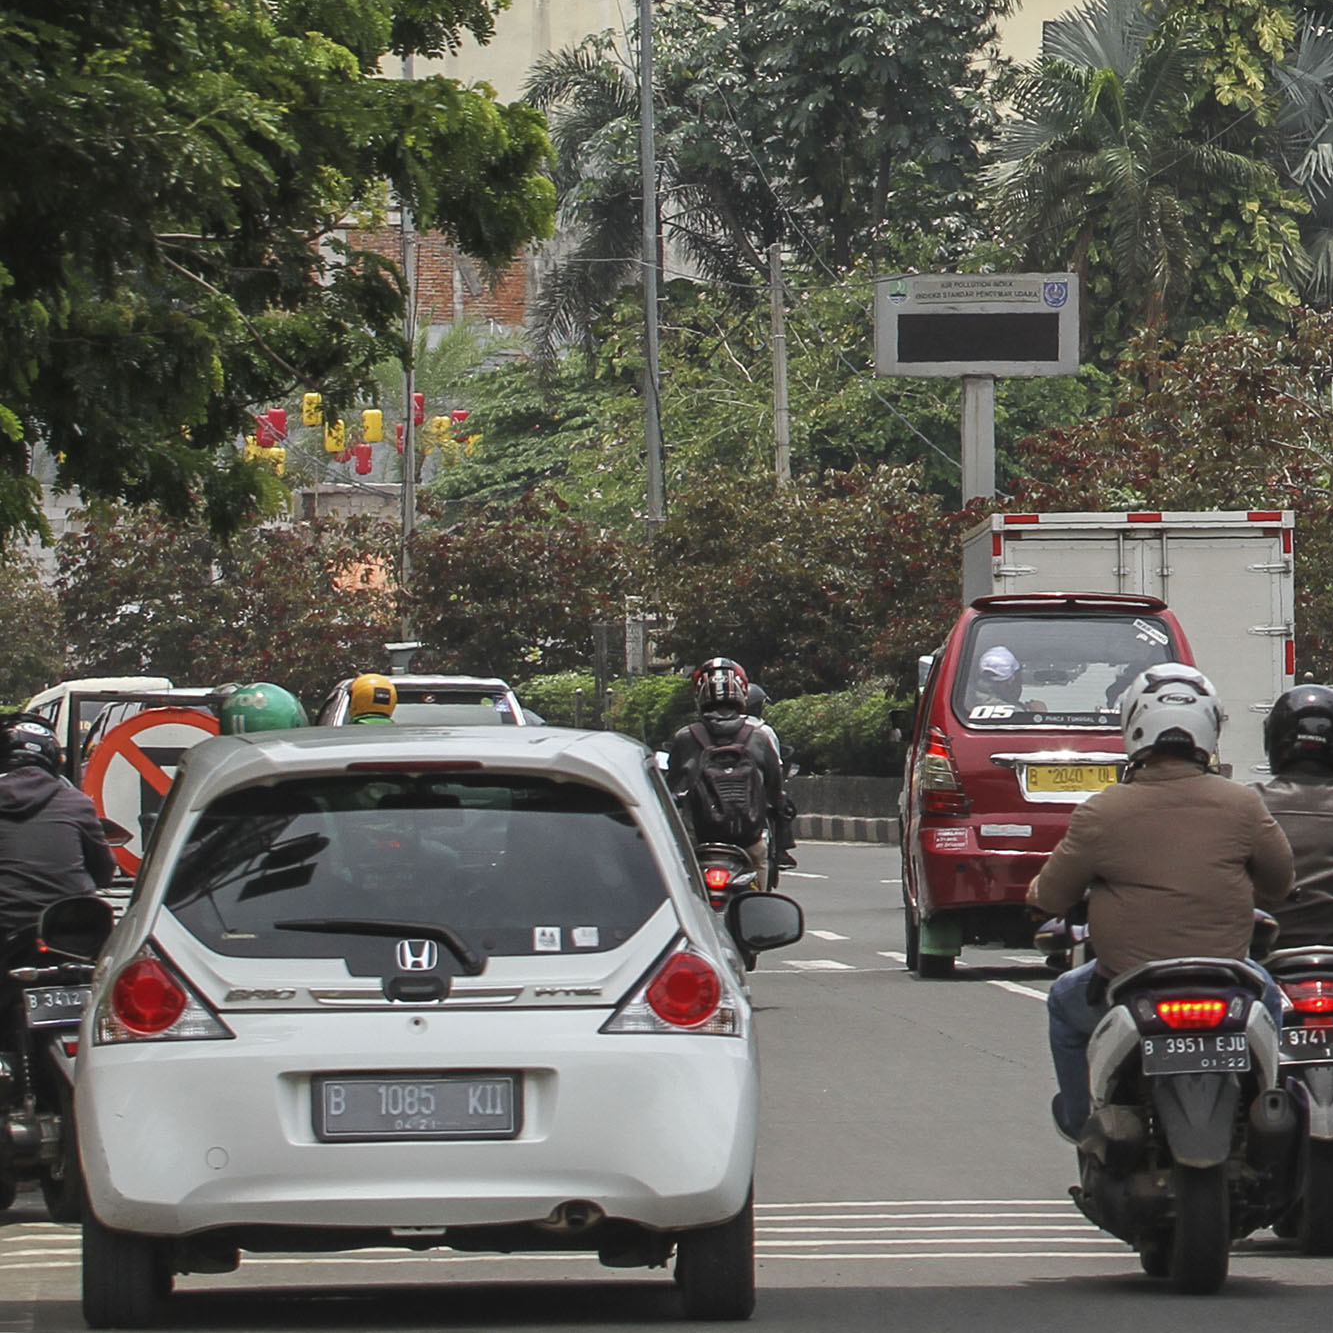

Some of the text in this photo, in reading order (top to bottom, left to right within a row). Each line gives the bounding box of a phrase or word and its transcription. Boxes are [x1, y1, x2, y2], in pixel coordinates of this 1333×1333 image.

[954, 280, 991, 289] POLLUTION
[969, 704, 1016, 719] 05
[27, 994, 38, 1008] B
[1145, 1036, 1246, 1055] B 3951 EJU
[330, 1084, 505, 1115] B 1085 KII
